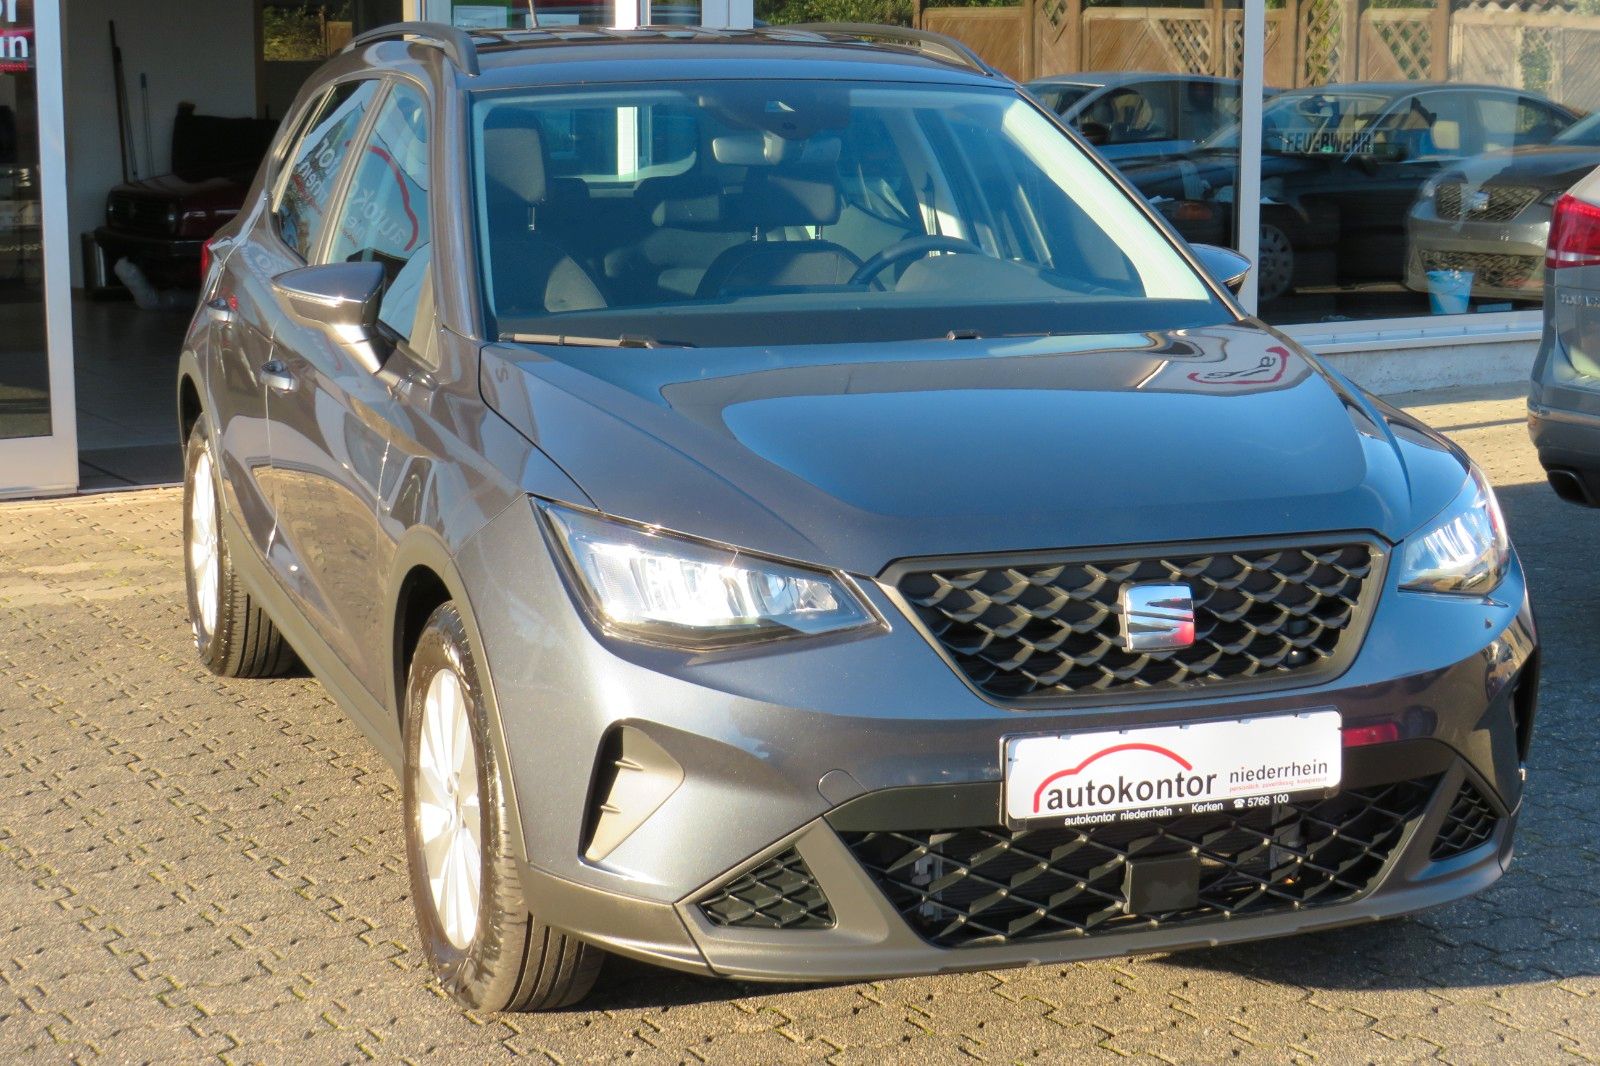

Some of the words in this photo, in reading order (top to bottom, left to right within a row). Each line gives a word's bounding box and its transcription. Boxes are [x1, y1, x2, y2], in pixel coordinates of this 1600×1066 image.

[1047, 771, 1217, 810] autokontor
[1229, 758, 1328, 783] niederrhein
[1064, 812, 1116, 826] autokontor
[1120, 806, 1173, 821] niederrhein
[1191, 802, 1223, 814] Kerken
[1247, 795, 1270, 807] 5766
[1273, 793, 1289, 804] 100
